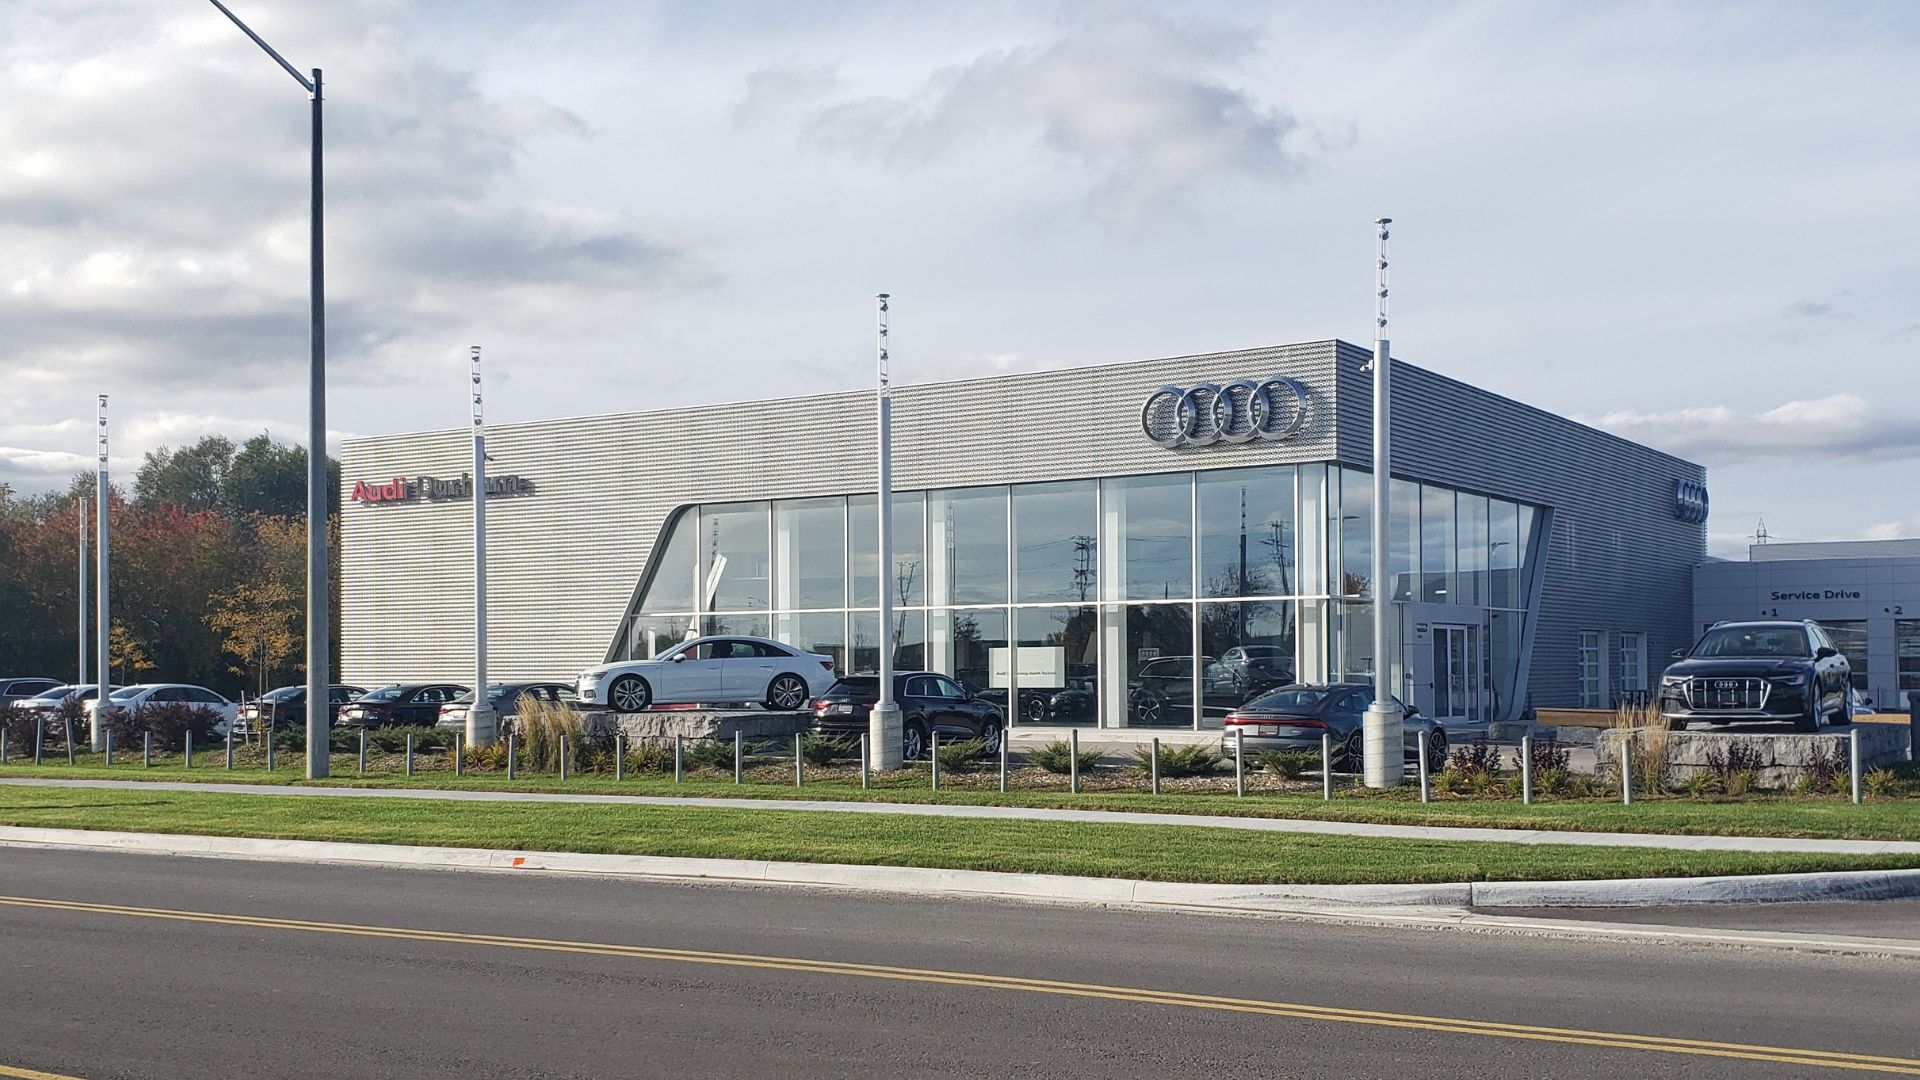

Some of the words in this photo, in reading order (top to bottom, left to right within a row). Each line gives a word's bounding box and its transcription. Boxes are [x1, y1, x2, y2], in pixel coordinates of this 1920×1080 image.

[352, 476, 406, 500] Audi
[1771, 590, 1820, 600] Service
[1824, 590, 1861, 599] Drive
[1771, 608, 1778, 617] 1
[1894, 606, 1903, 615] 2
